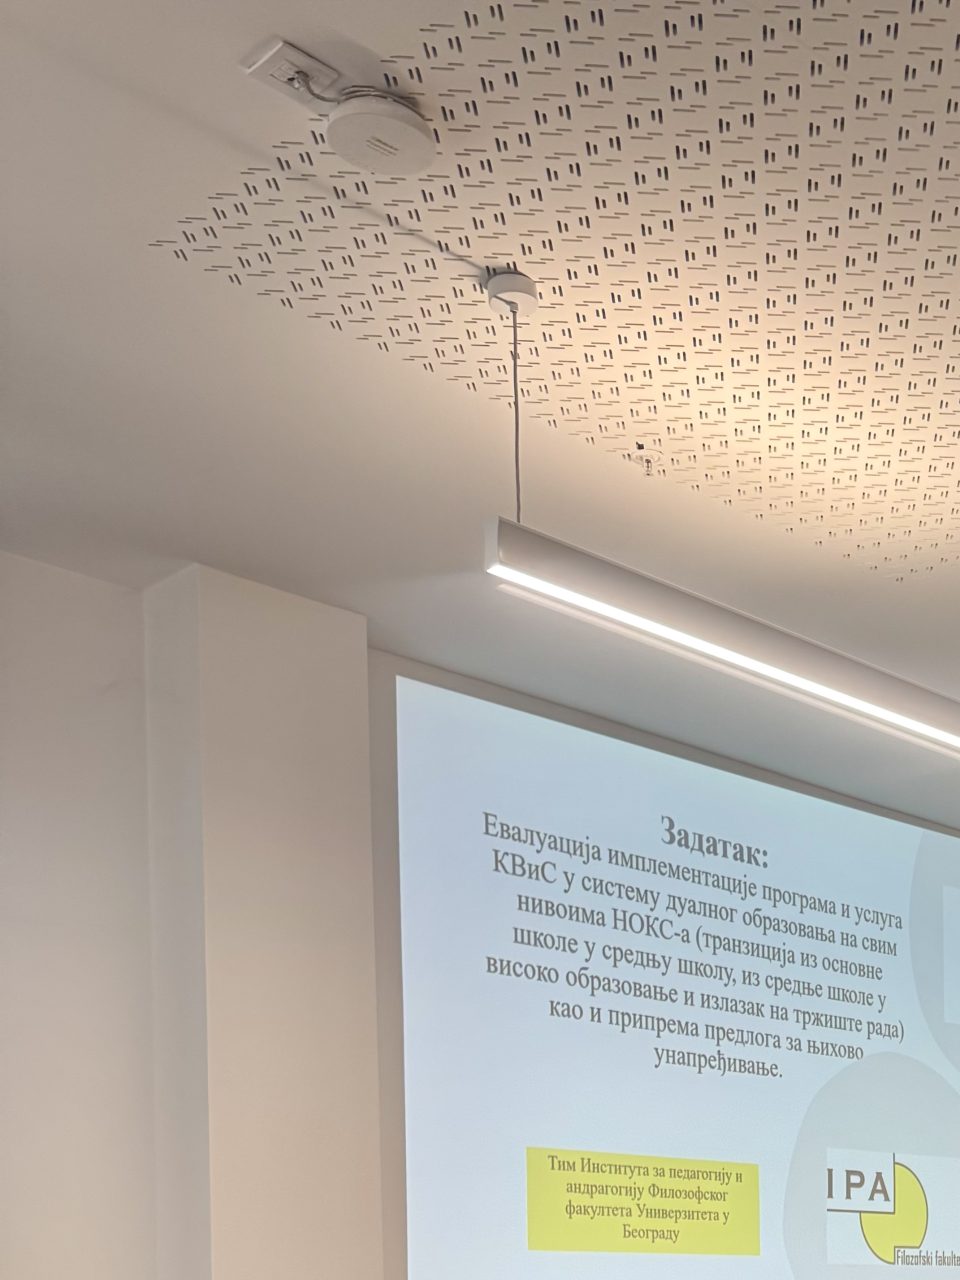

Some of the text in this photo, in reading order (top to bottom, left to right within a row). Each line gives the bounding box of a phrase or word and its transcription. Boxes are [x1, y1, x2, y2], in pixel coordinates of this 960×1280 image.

[662, 816, 768, 868] Задатак:
[483, 812, 902, 931] Евалуација имплементације програма и услуга
[492, 849, 896, 956] КВиС у систему дуалног образовања на свим
[517, 894, 883, 980] нивоима НОКС-а (транзиција из основне
[513, 927, 886, 1013] школе у средњу школу, из средње школе у
[486, 956, 904, 1044] високо образовање и излазак на тржиште рада)
[549, 1000, 864, 1060] као и припрема предлога за њихово
[654, 1047, 782, 1078] унапређивање.
[548, 1155, 743, 1186] Тим Института за педагогију и
[827, 1168, 891, 1202] IPA
[565, 1199, 730, 1225] факултета Универзитета у
[566, 1181, 728, 1204] андрагогију Филозофског
[622, 1223, 680, 1244] Београду
[896, 1249, 933, 1266] Filozofski
